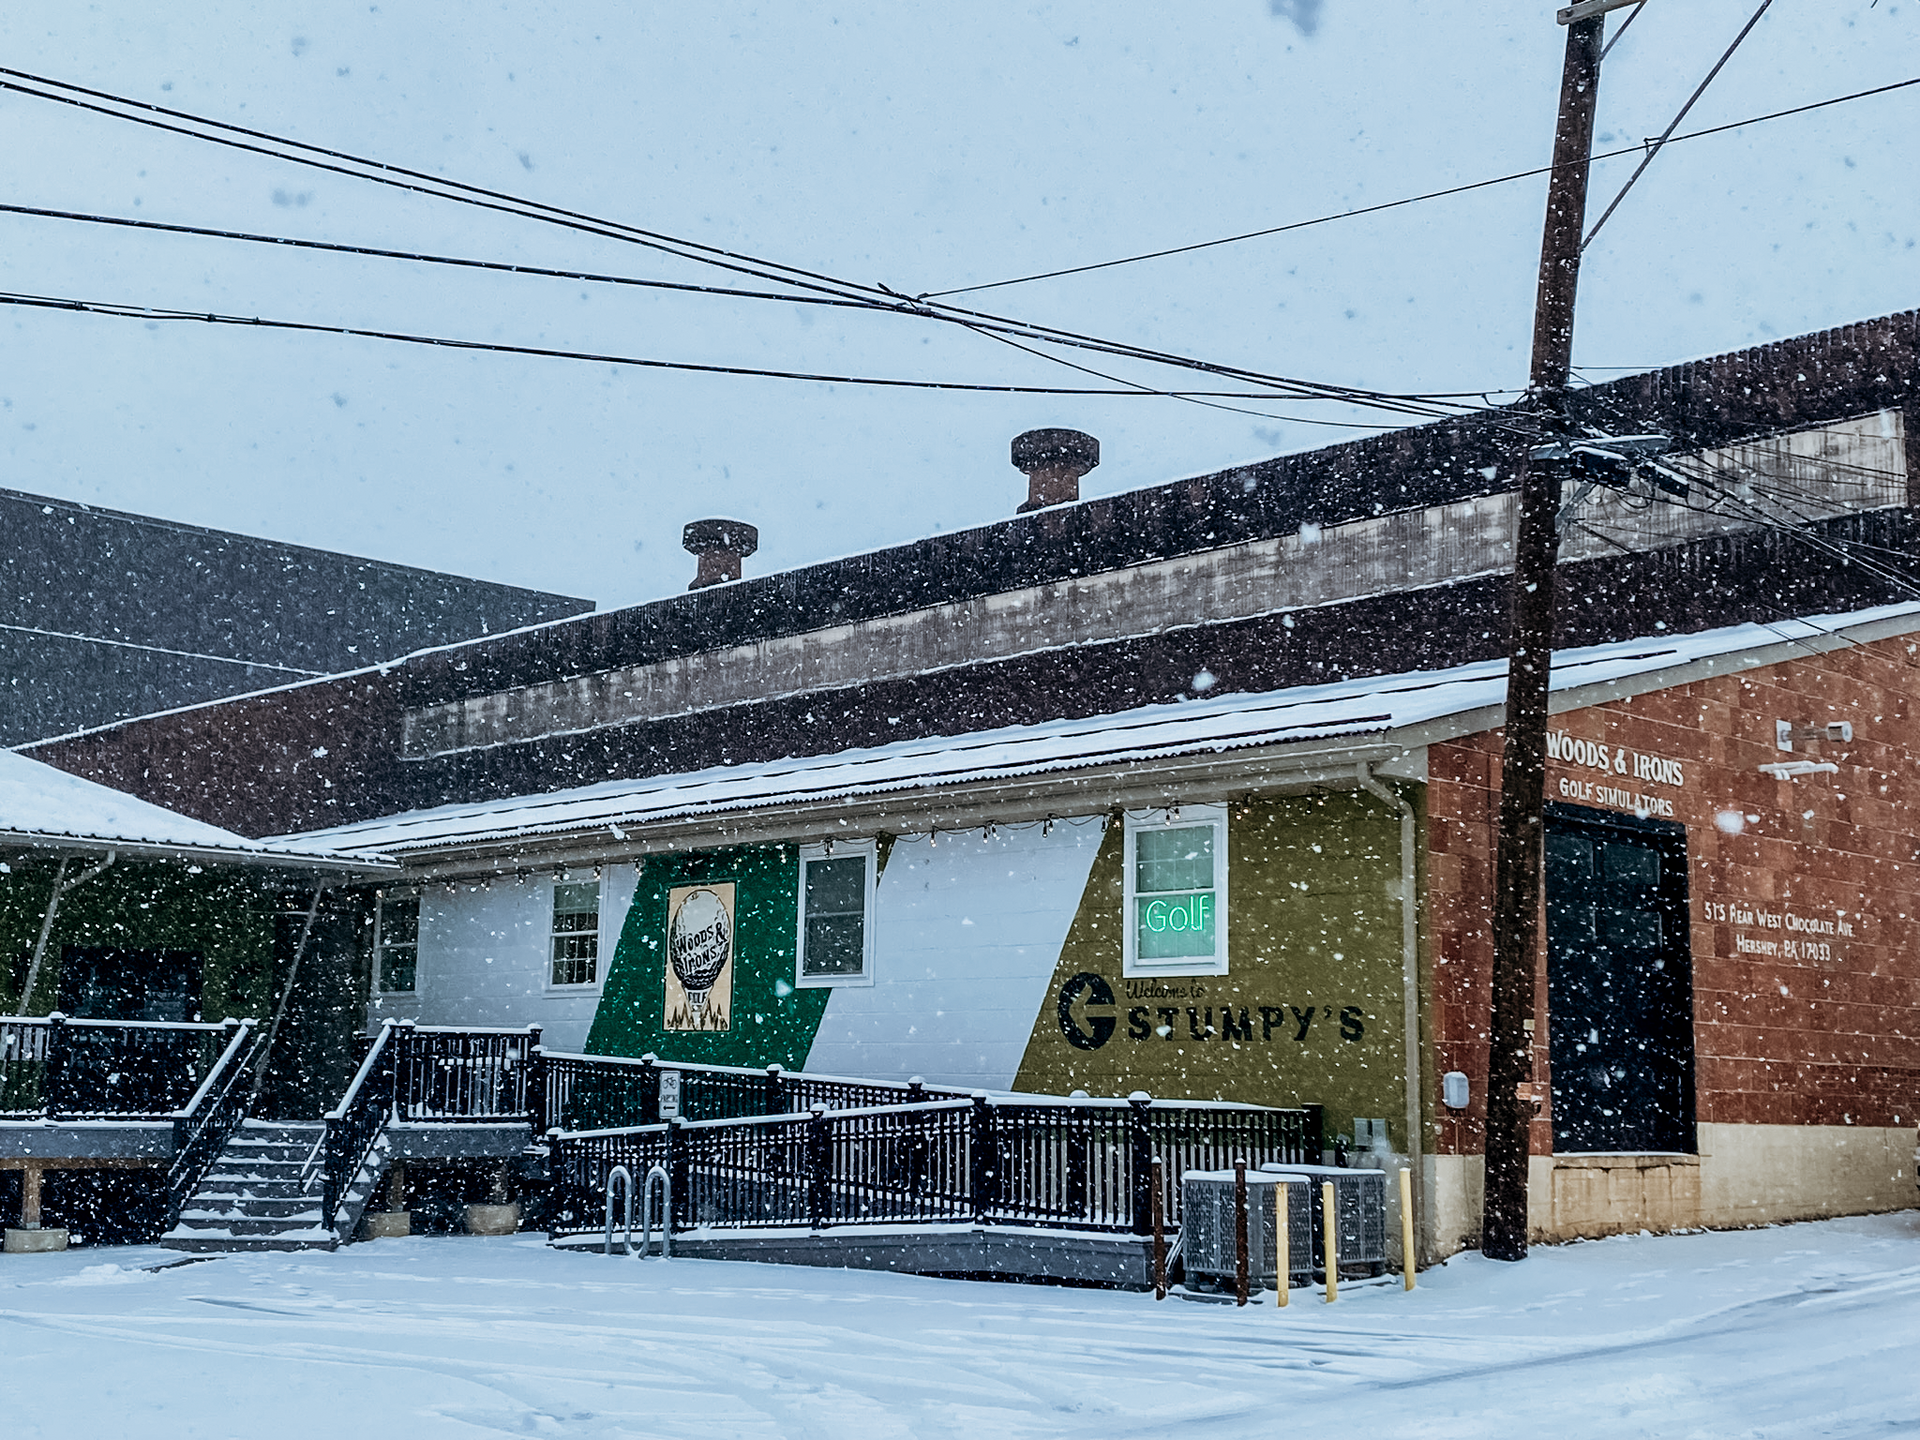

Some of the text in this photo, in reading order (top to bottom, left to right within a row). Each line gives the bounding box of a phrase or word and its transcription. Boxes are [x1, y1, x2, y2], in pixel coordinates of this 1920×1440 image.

[1546, 730, 1684, 786] WOODS & IRONS
[1559, 777, 1674, 817] GOLF SIMULATORS
[1146, 894, 1210, 932] Golf
[1756, 908, 1782, 929] WEST
[1784, 912, 1834, 935] CHOCOLATE
[1801, 941, 1831, 961] 17033
[1128, 1005, 1365, 1042] STUMPY'S
